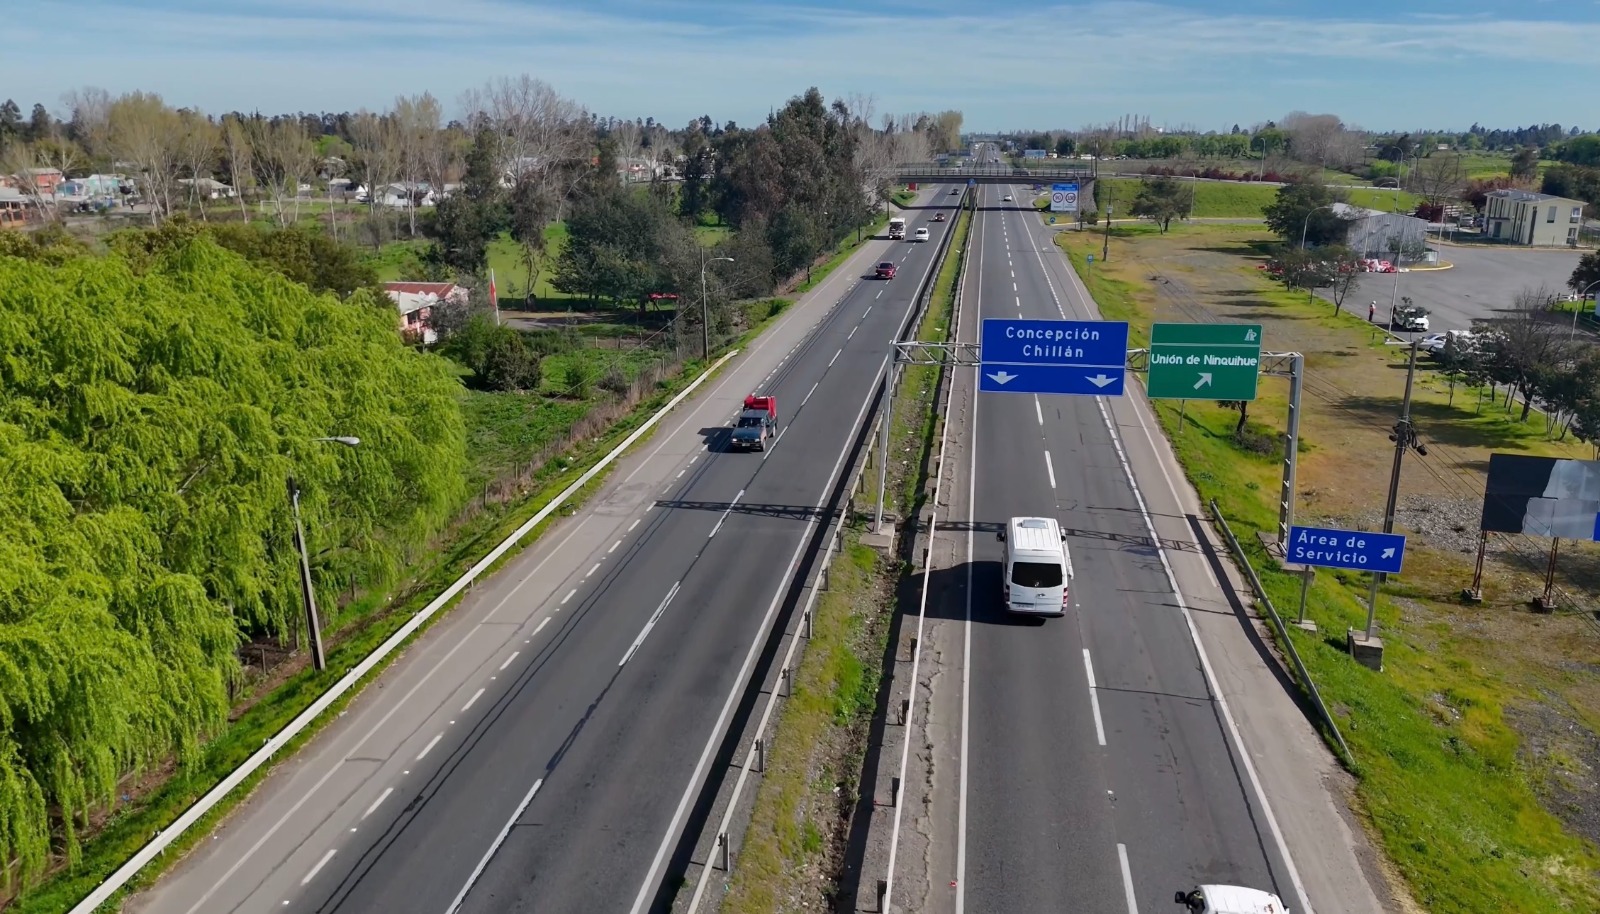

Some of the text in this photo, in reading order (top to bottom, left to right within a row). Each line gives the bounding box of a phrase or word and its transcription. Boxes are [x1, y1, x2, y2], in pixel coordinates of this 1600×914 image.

[1006, 326, 1100, 341] Concepción
[1022, 344, 1084, 358] Chillán
[1151, 353, 1183, 365] Unión
[1186, 354, 1200, 365] de
[1297, 529, 1366, 549] Área de
[1296, 546, 1367, 564] Servicio
